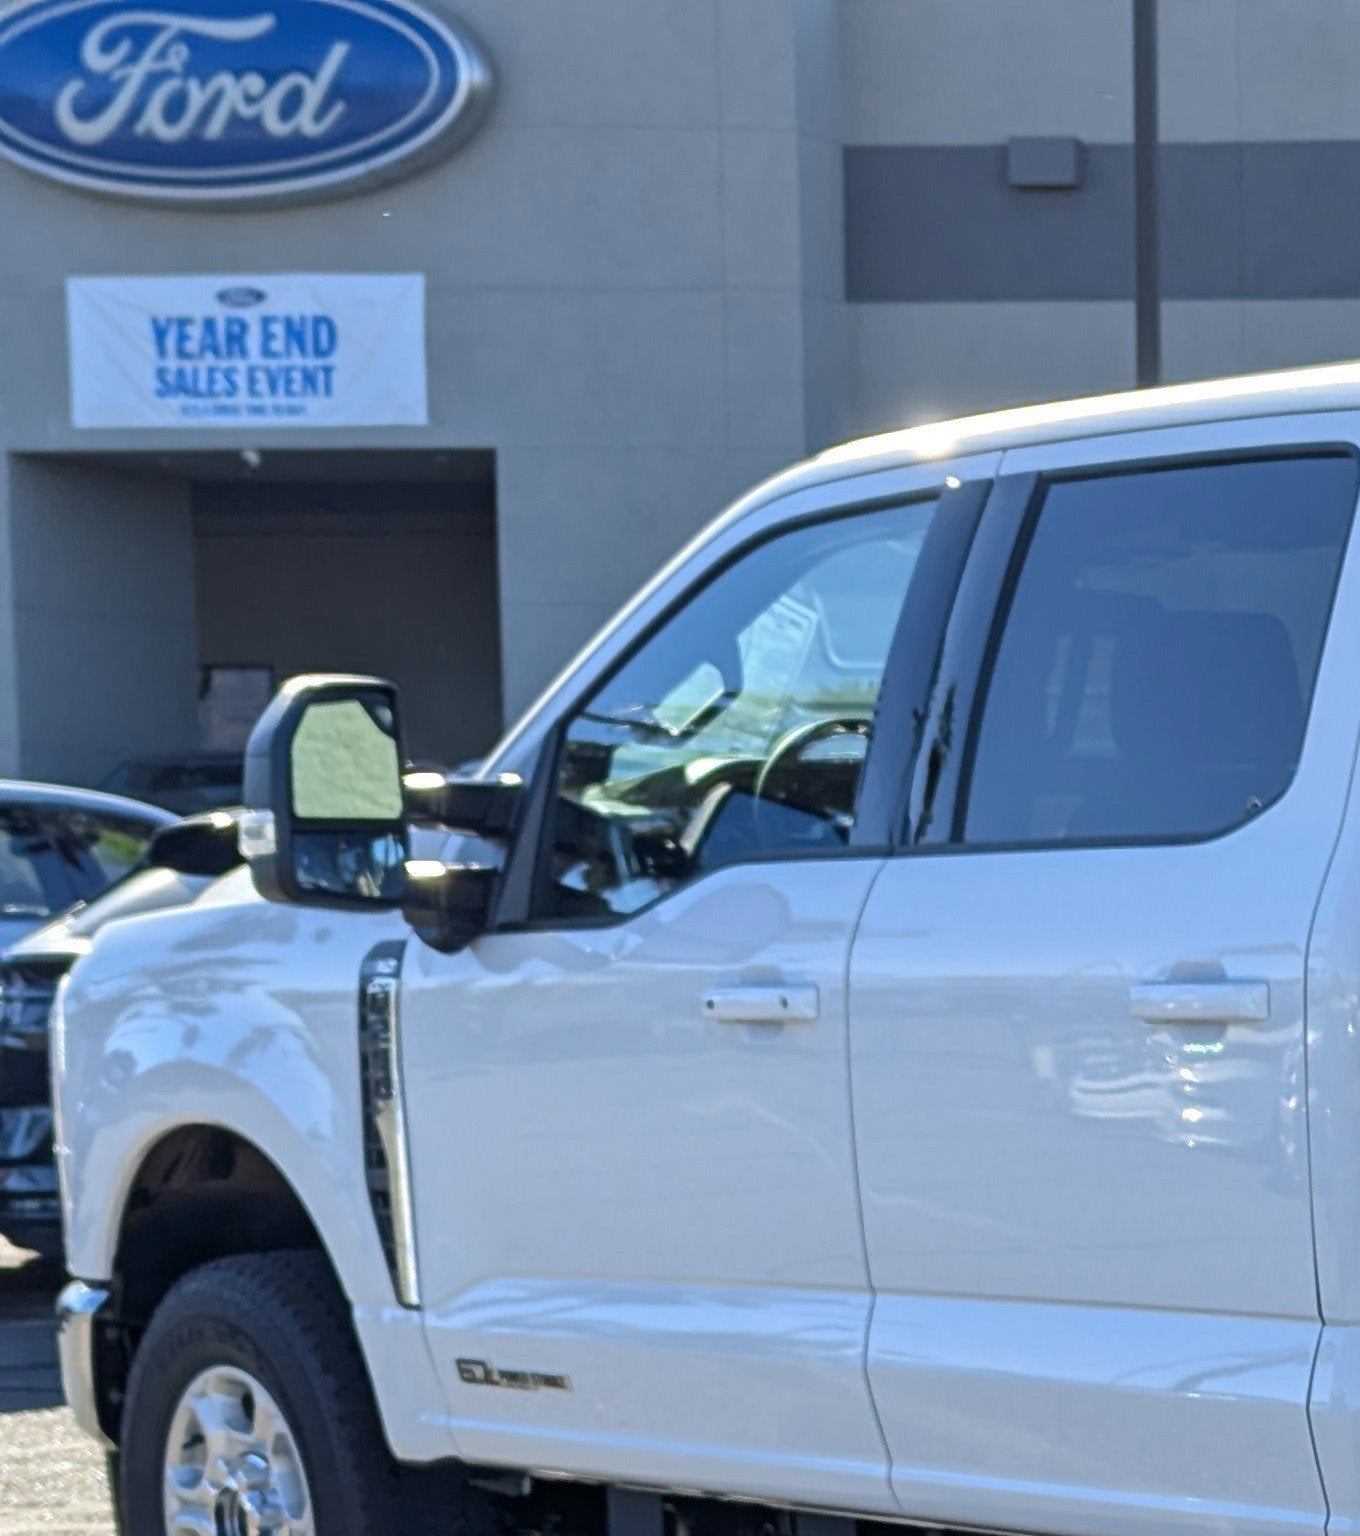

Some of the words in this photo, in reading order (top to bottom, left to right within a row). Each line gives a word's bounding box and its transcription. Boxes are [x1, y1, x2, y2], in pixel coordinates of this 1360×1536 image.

[54, 10, 352, 145] Ford
[151, 314, 249, 361] YEAR
[260, 313, 339, 360] END
[154, 365, 240, 400] SALES
[247, 364, 335, 399] EVENT
